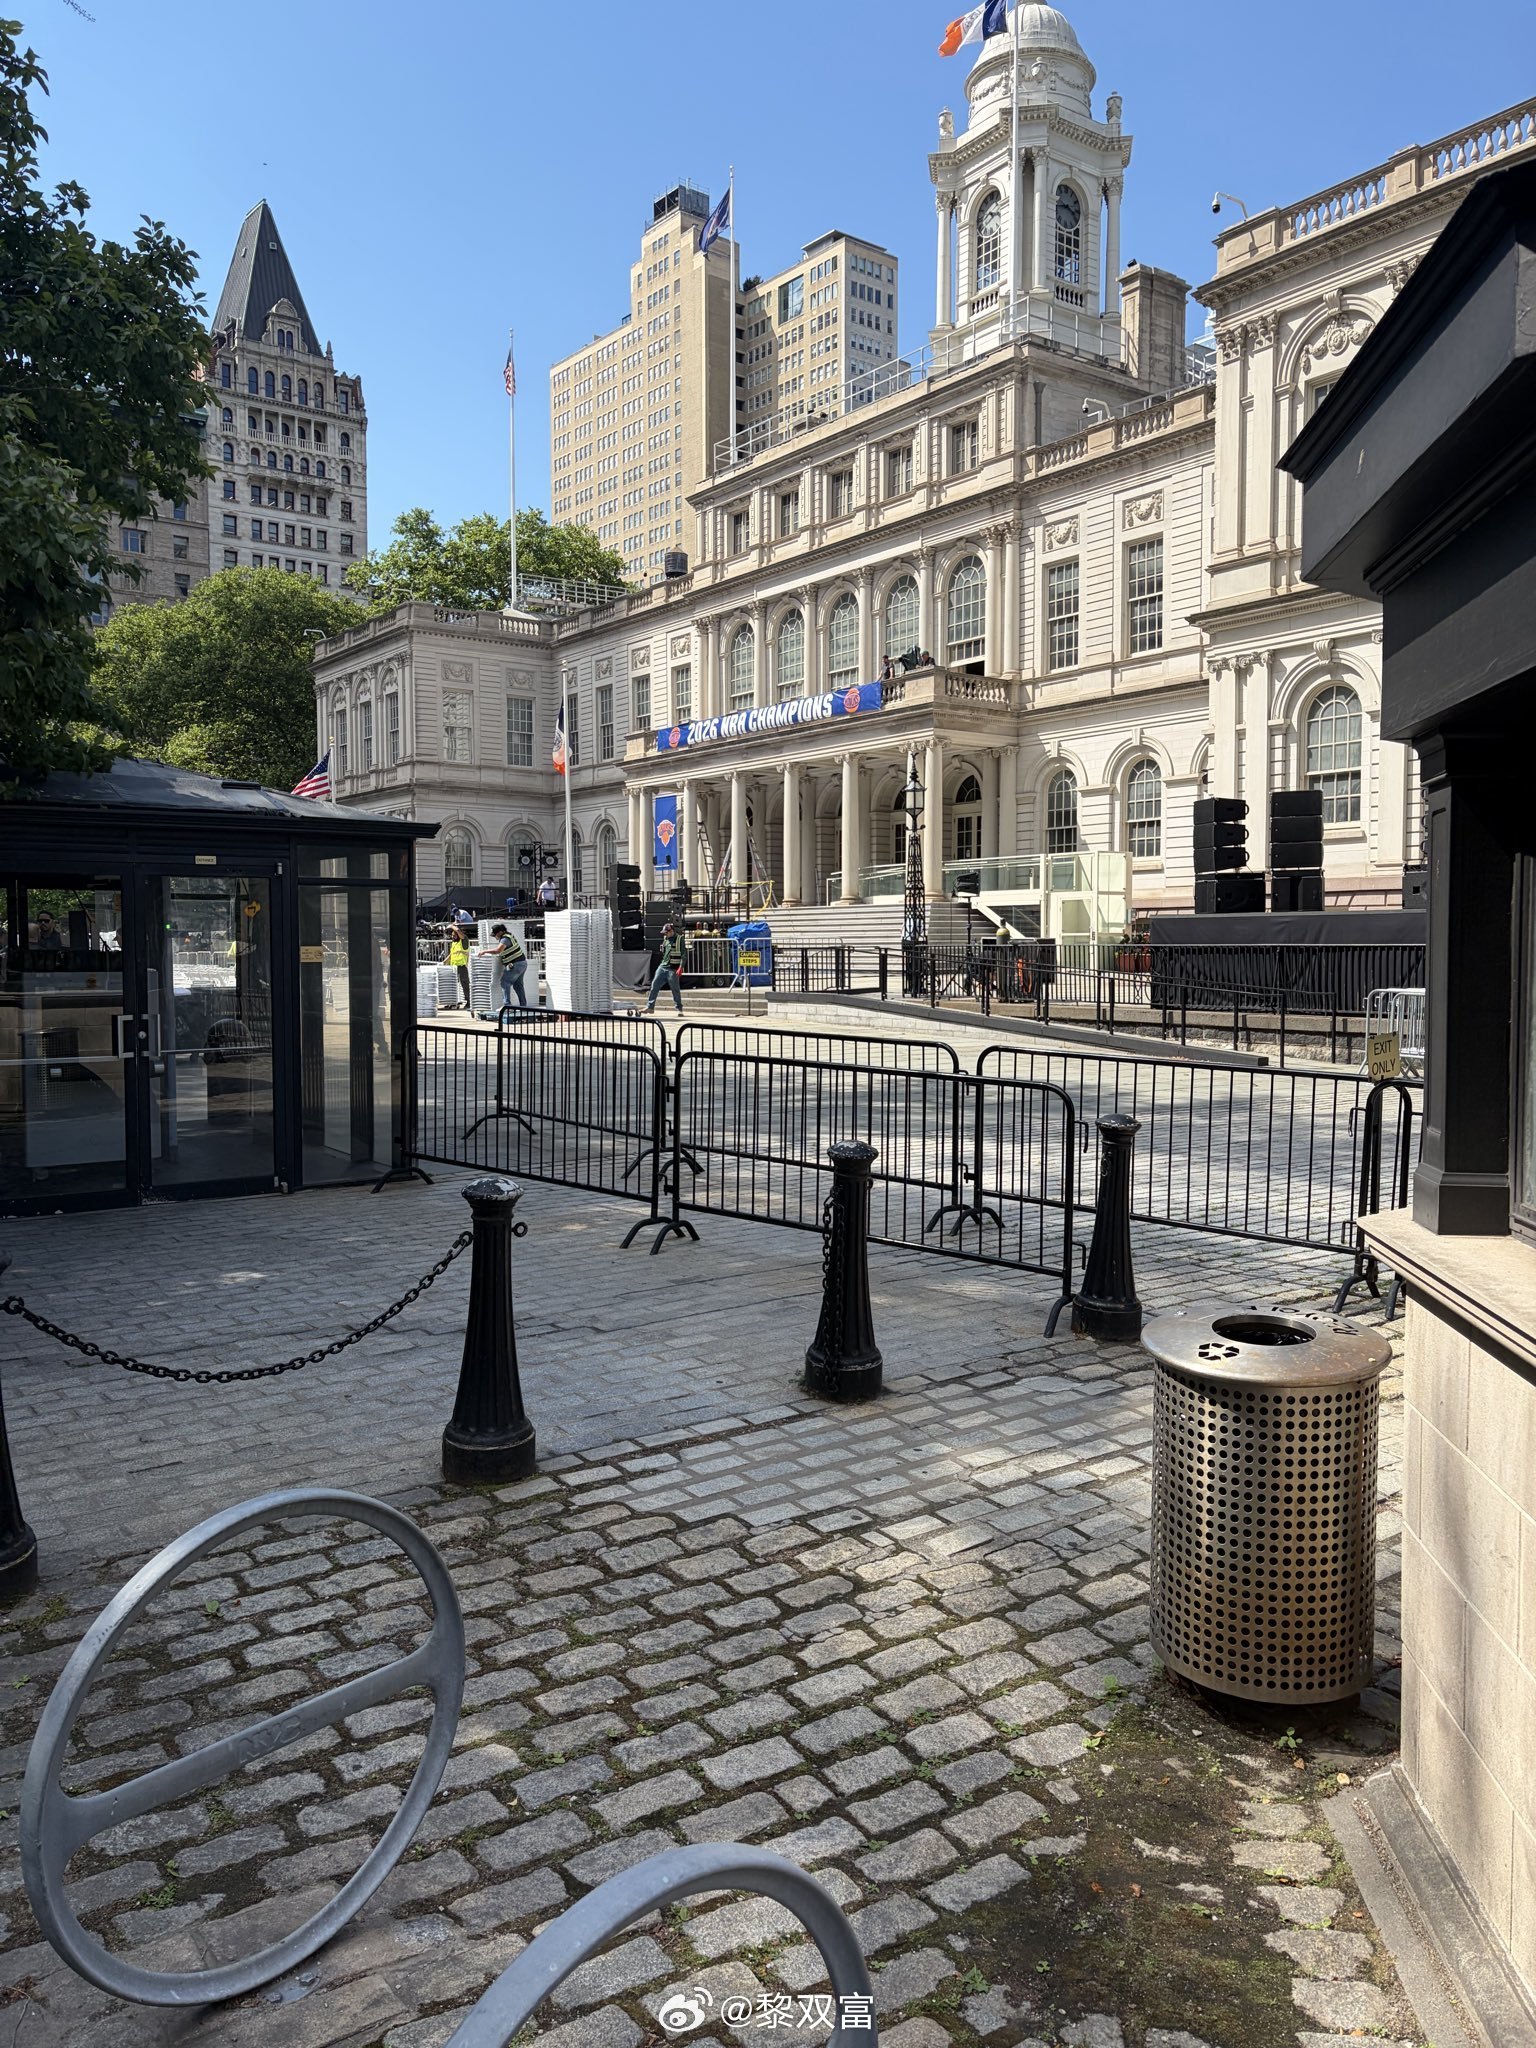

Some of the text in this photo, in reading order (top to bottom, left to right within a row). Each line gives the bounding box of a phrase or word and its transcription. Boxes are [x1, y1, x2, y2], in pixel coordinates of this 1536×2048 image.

[687, 718, 720, 745] 2026
[720, 712, 747, 738] NBA
[748, 693, 834, 732] CHAMPIONS
[1374, 1040, 1392, 1055] EXIT
[1372, 1058, 1395, 1075] ONLY
